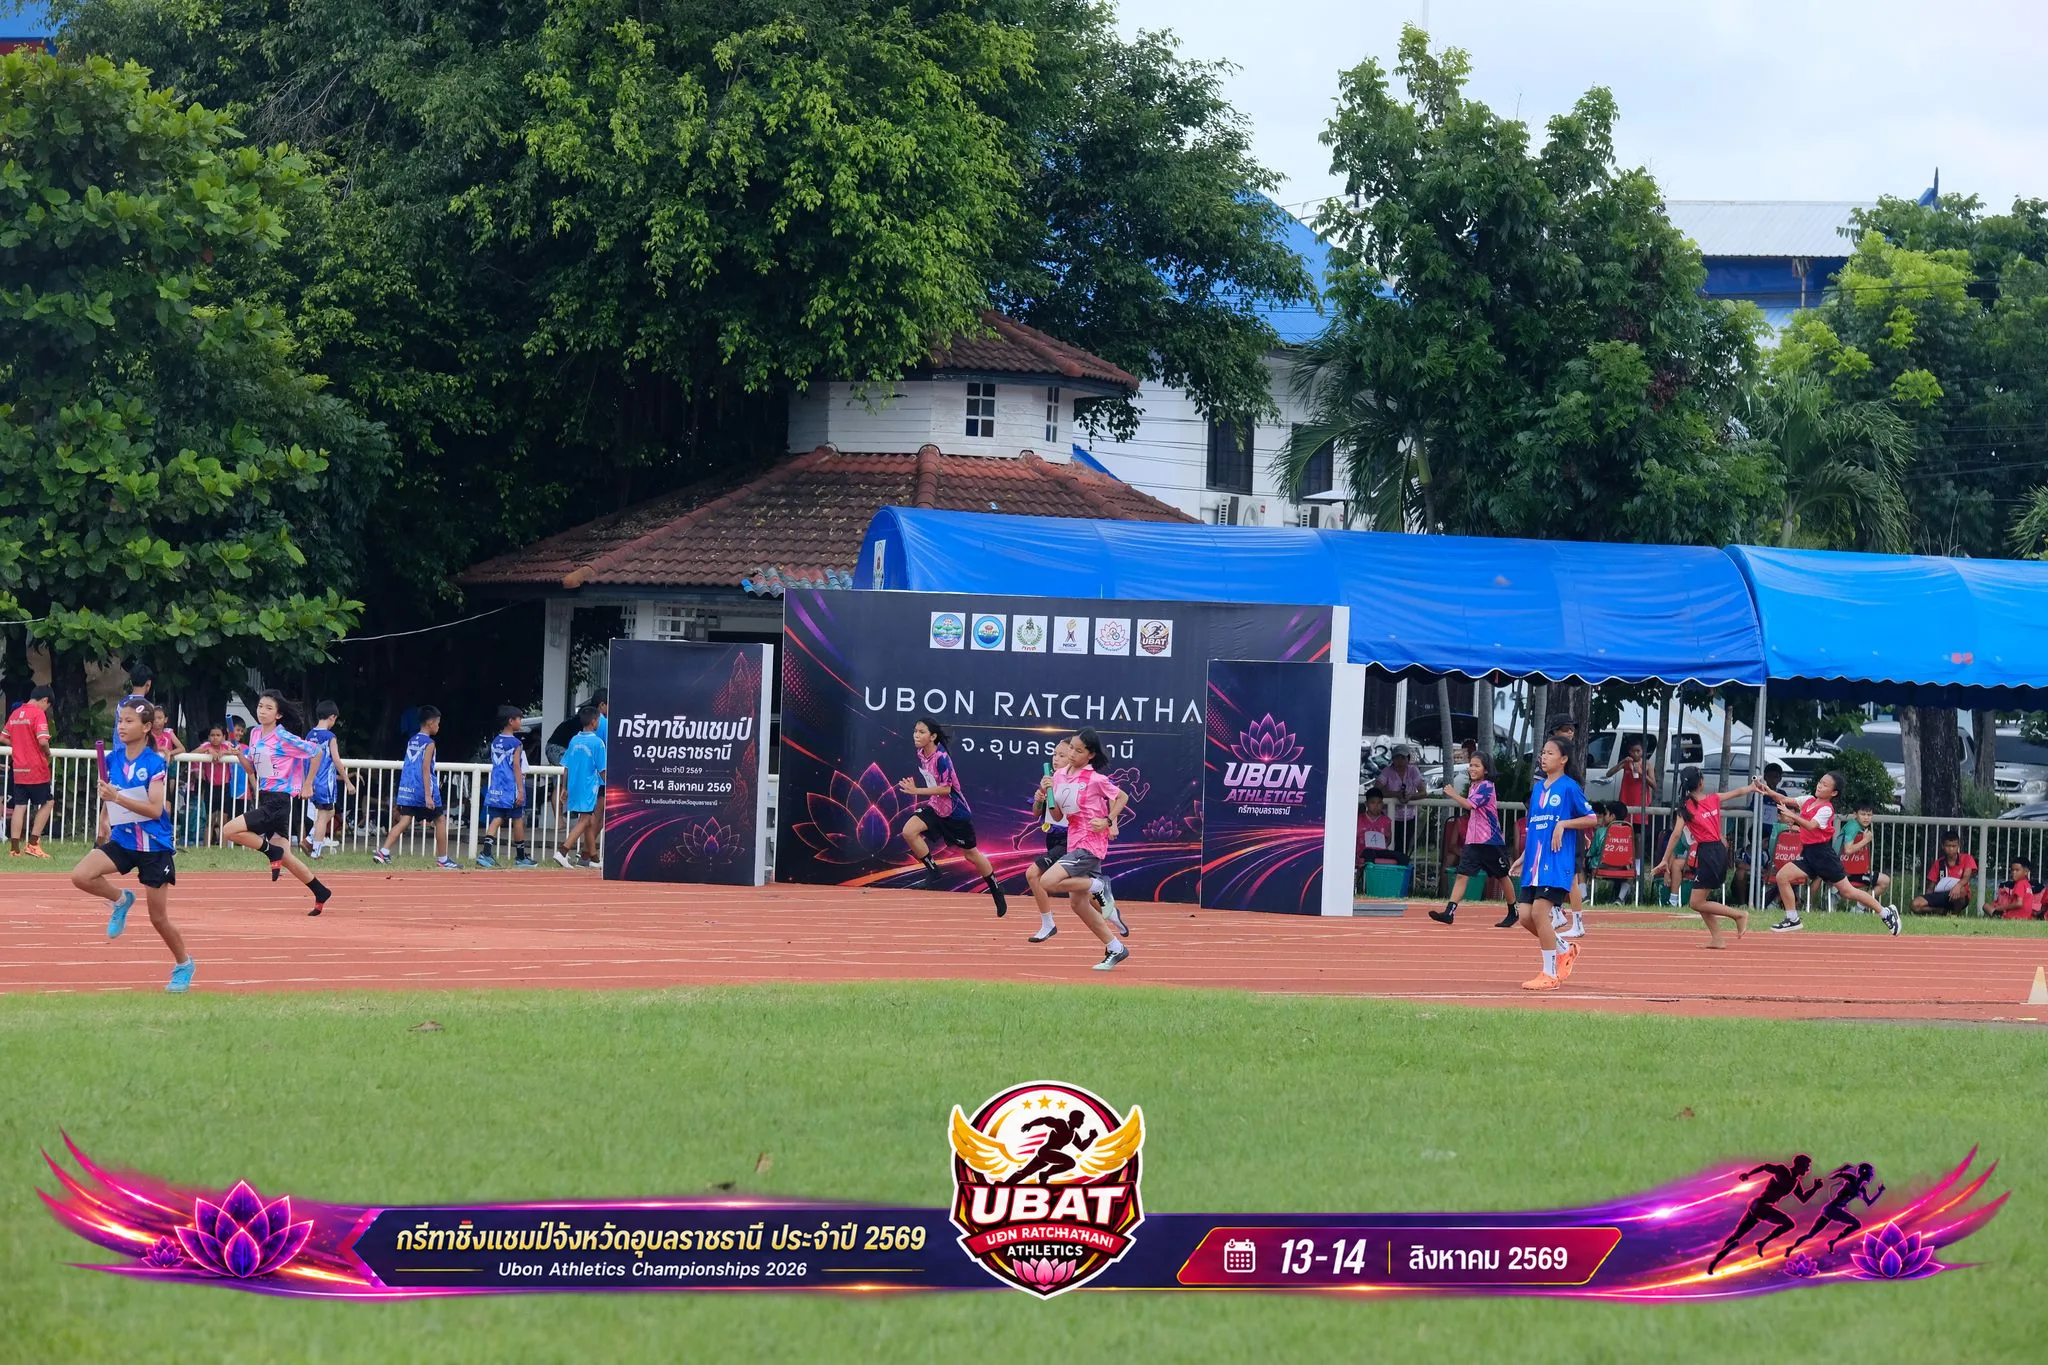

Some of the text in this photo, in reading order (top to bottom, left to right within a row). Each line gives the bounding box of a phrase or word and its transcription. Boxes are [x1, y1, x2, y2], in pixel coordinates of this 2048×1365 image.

[864, 686, 1203, 725] UBON RATCHATHA
[617, 712, 753, 741] กรีฑาชิงแชมป์
[632, 743, 733, 763] จ.อุบลราชธานี
[686, 766, 703, 774] 2569
[1223, 762, 1313, 789] UBON
[667, 780, 704, 792] สิงหาคม
[707, 782, 732, 793] 2569
[1223, 788, 1309, 803] ATHLETICS
[1061, 787, 1071, 809] 2
